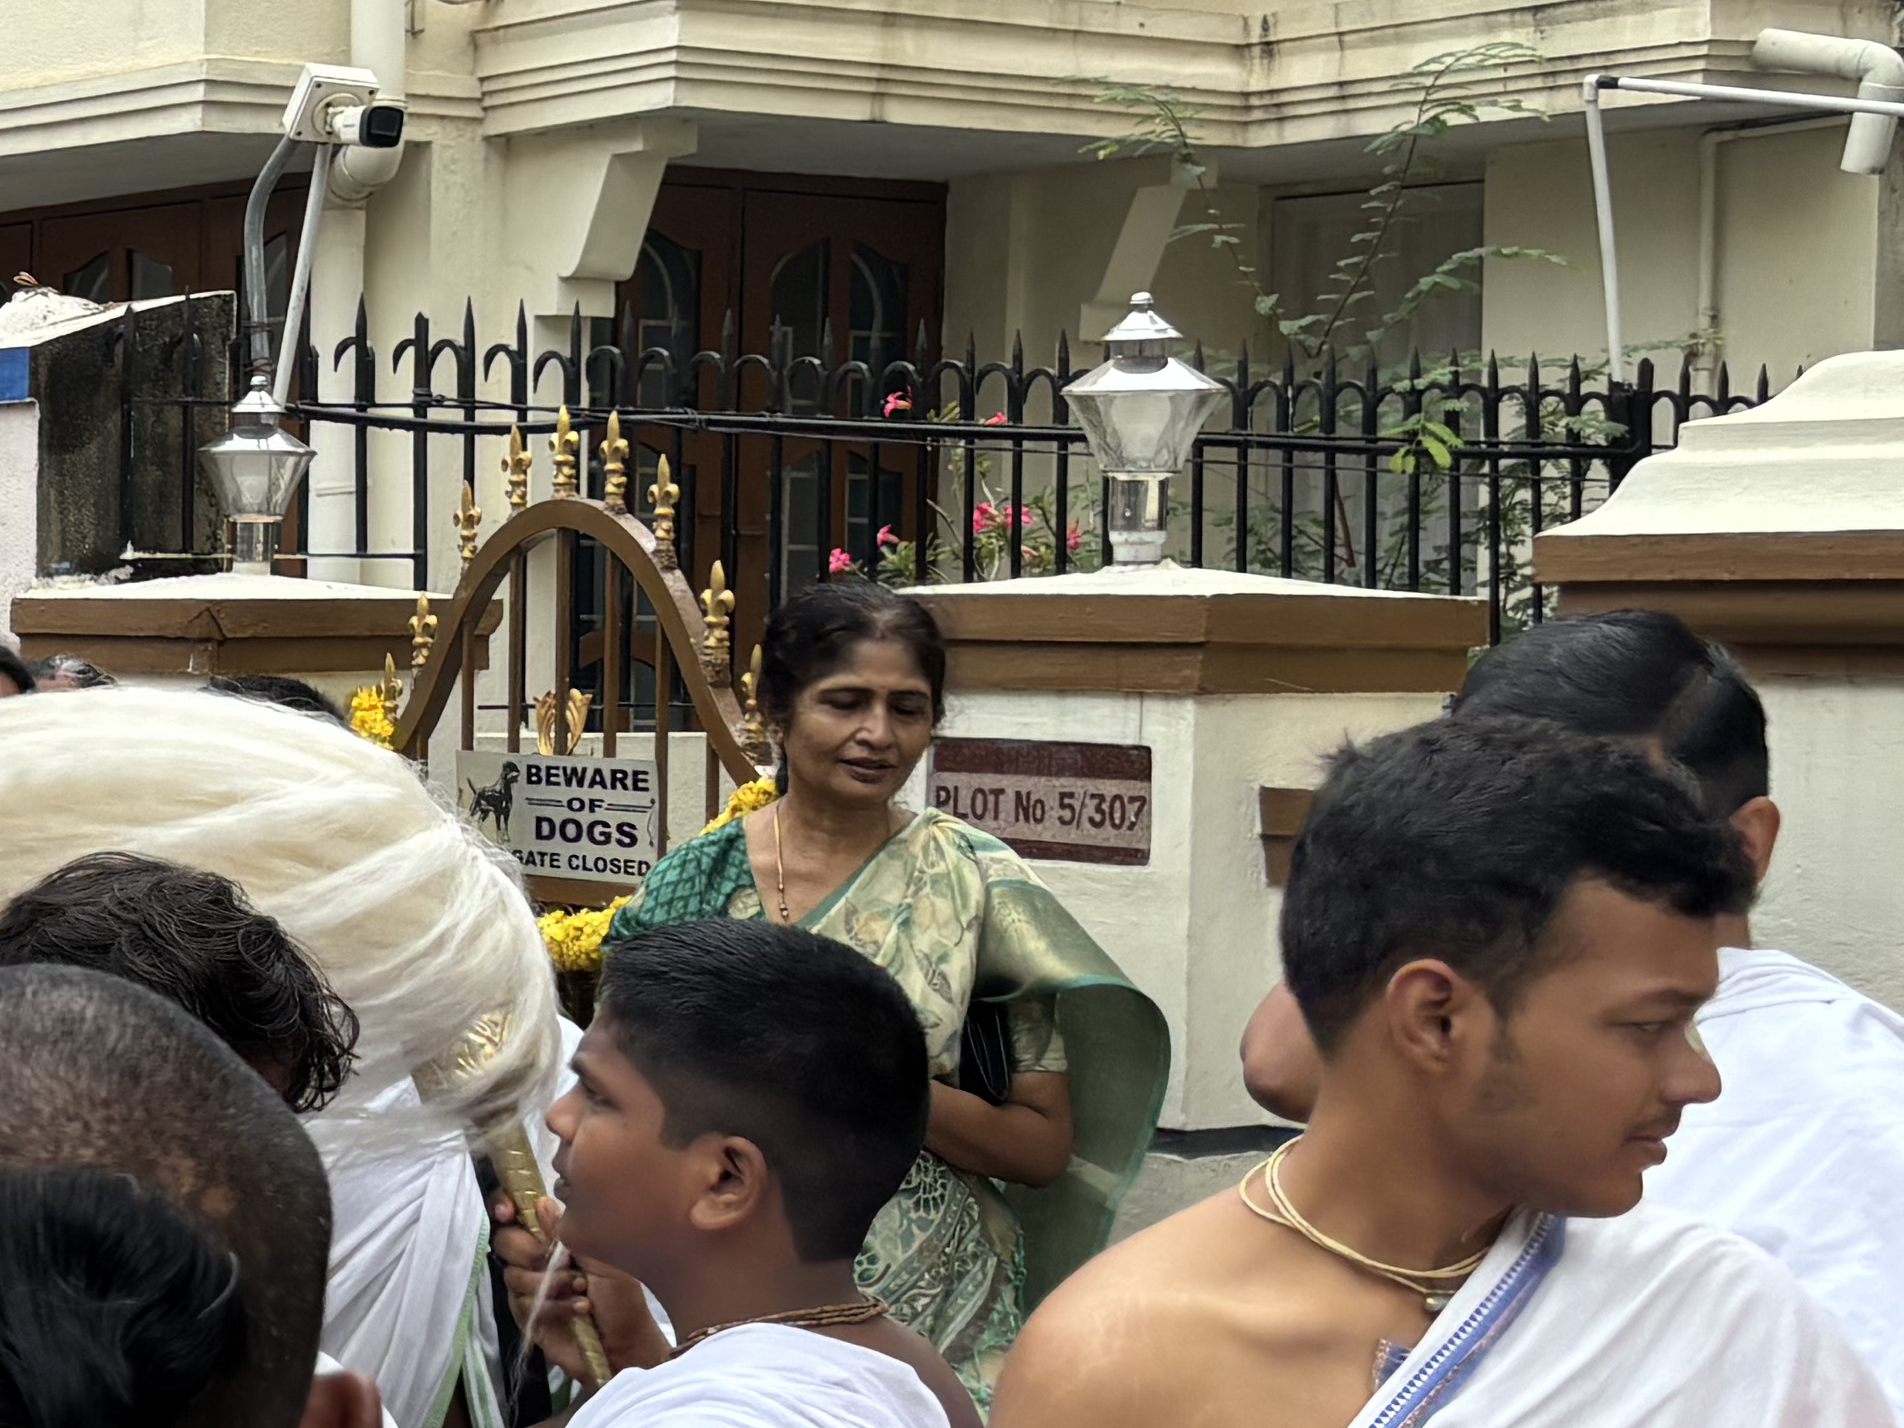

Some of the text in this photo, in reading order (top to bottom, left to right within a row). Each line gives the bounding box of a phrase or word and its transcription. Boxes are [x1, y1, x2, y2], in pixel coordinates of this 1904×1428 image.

[526, 764, 650, 792] BEWARE
[566, 797, 606, 814] OF
[935, 785, 1147, 832] PLOT No 5/307
[535, 815, 639, 848] DOGS
[567, 854, 652, 877] CLOSED
